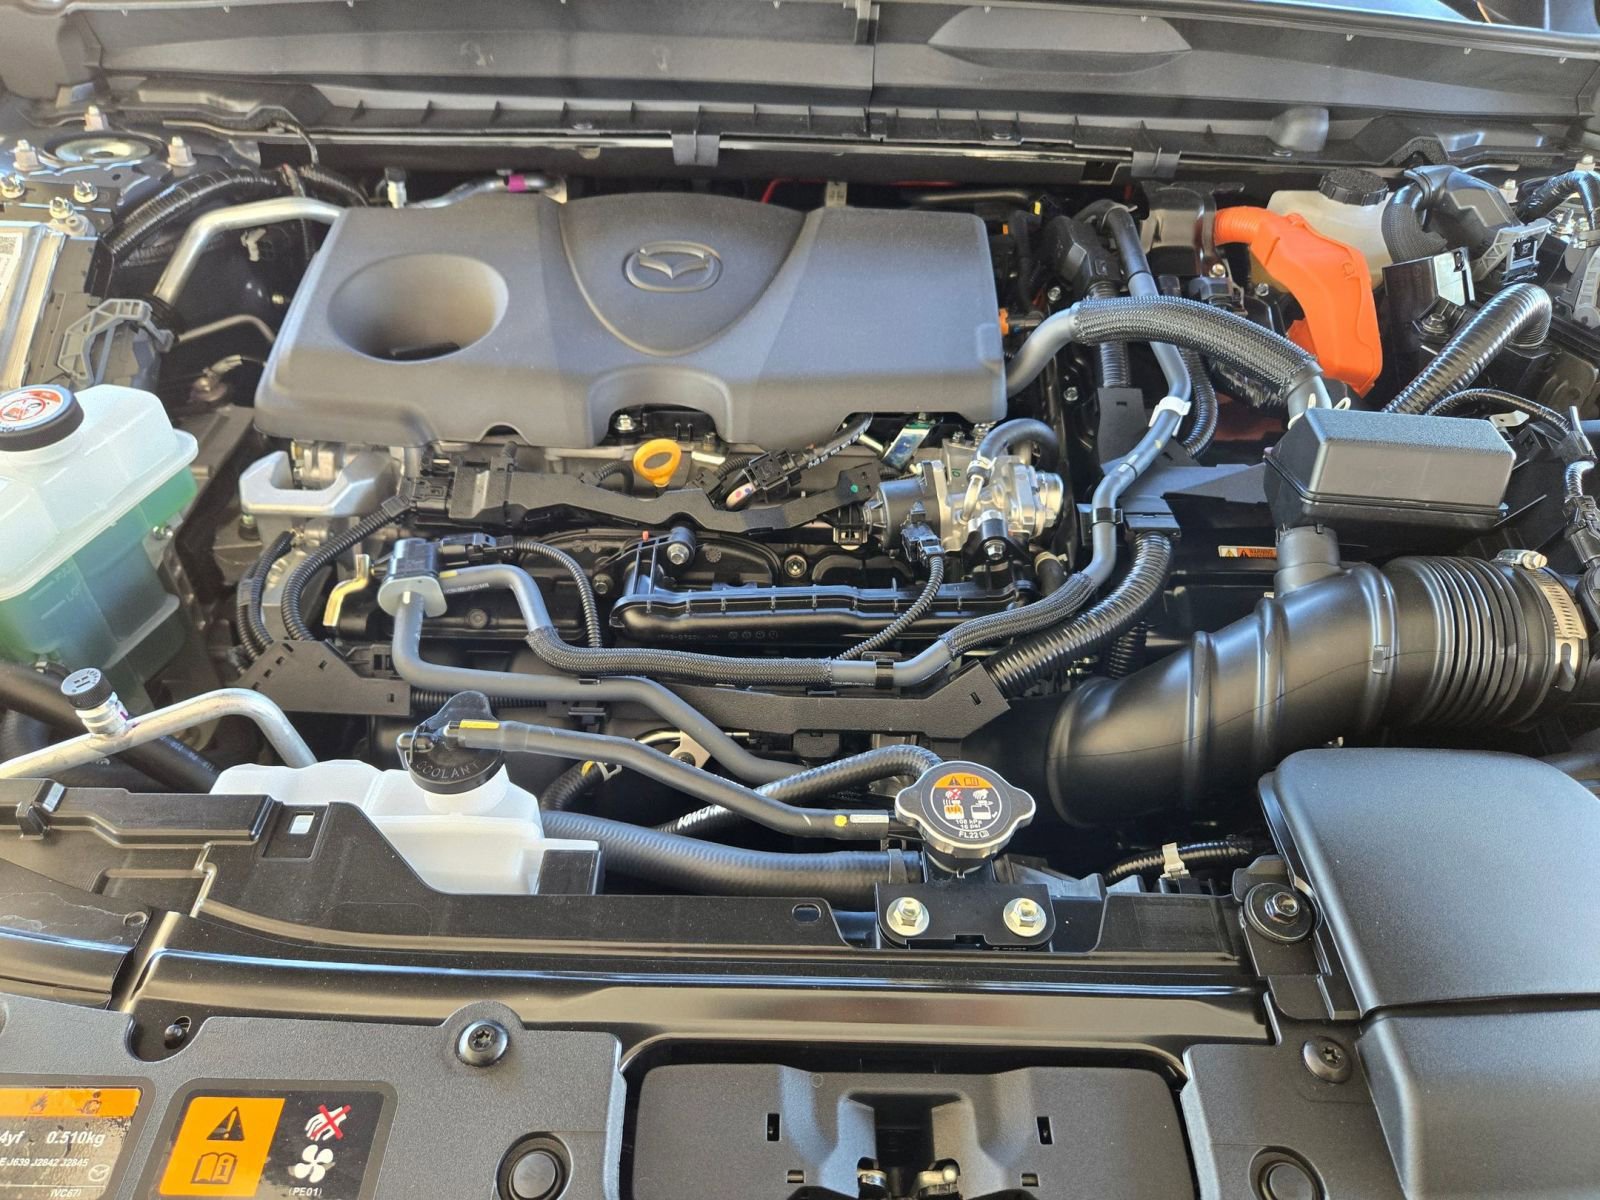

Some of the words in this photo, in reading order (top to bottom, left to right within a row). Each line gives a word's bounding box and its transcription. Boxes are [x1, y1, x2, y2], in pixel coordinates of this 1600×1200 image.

[958, 830, 979, 839] FL22
[46, 1131, 106, 1147] 0.510kg
[7, 1158, 30, 1167] J639
[30, 1158, 58, 1167] J2842
